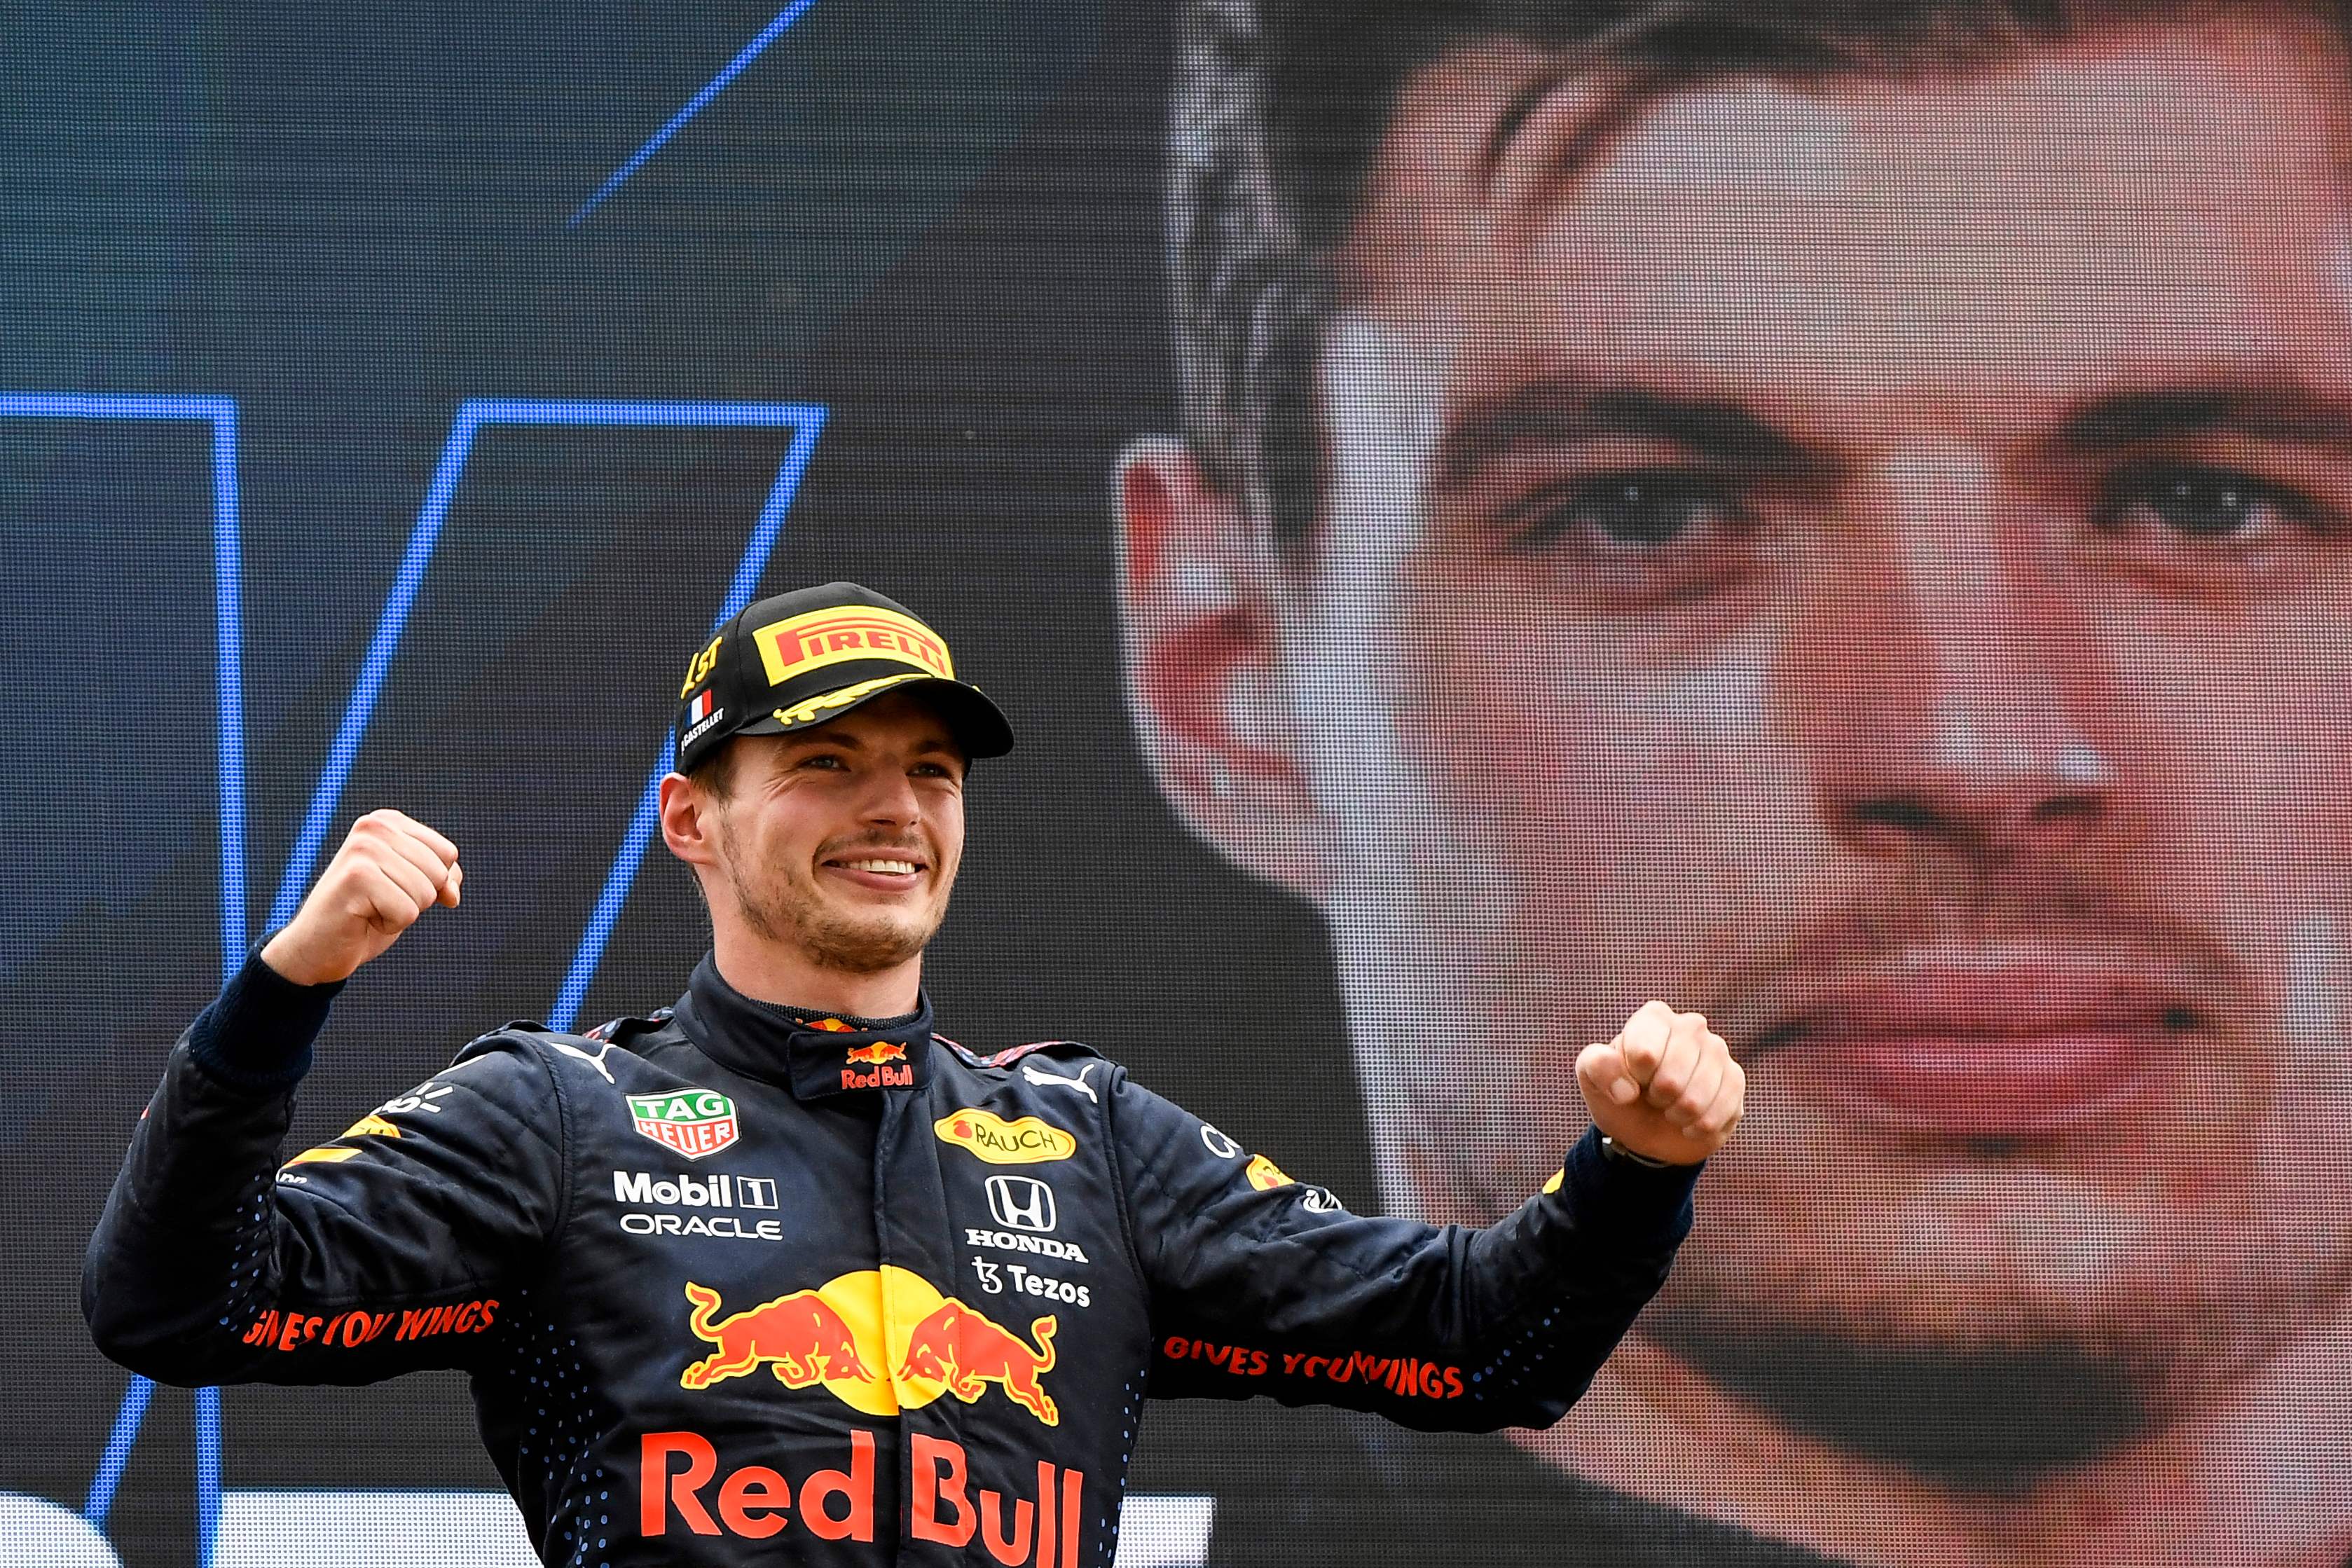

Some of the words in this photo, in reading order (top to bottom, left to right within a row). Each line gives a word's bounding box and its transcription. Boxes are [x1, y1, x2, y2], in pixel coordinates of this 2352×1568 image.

[776, 617, 947, 676] PIRELLI
[680, 635, 723, 700] 1ST
[683, 707, 724, 748] CASTELLET
[841, 1066, 880, 1090] Red
[883, 1064, 914, 1087] Bull
[635, 1093, 725, 1121] TAG
[638, 1121, 733, 1154] HEUER
[975, 1124, 1057, 1152] RAUCH
[613, 1171, 733, 1208] Mobil
[620, 1213, 783, 1241] ORACLE
[965, 1228, 1089, 1263] HONDA
[1007, 1264, 1091, 1308] Tezos
[395, 1299, 499, 1341] WINGS
[1164, 1336, 1268, 1375] GIVES
[1353, 1350, 1464, 1398] WINGS
[640, 1429, 875, 1543] Red
[911, 1432, 1084, 1568] Bull
